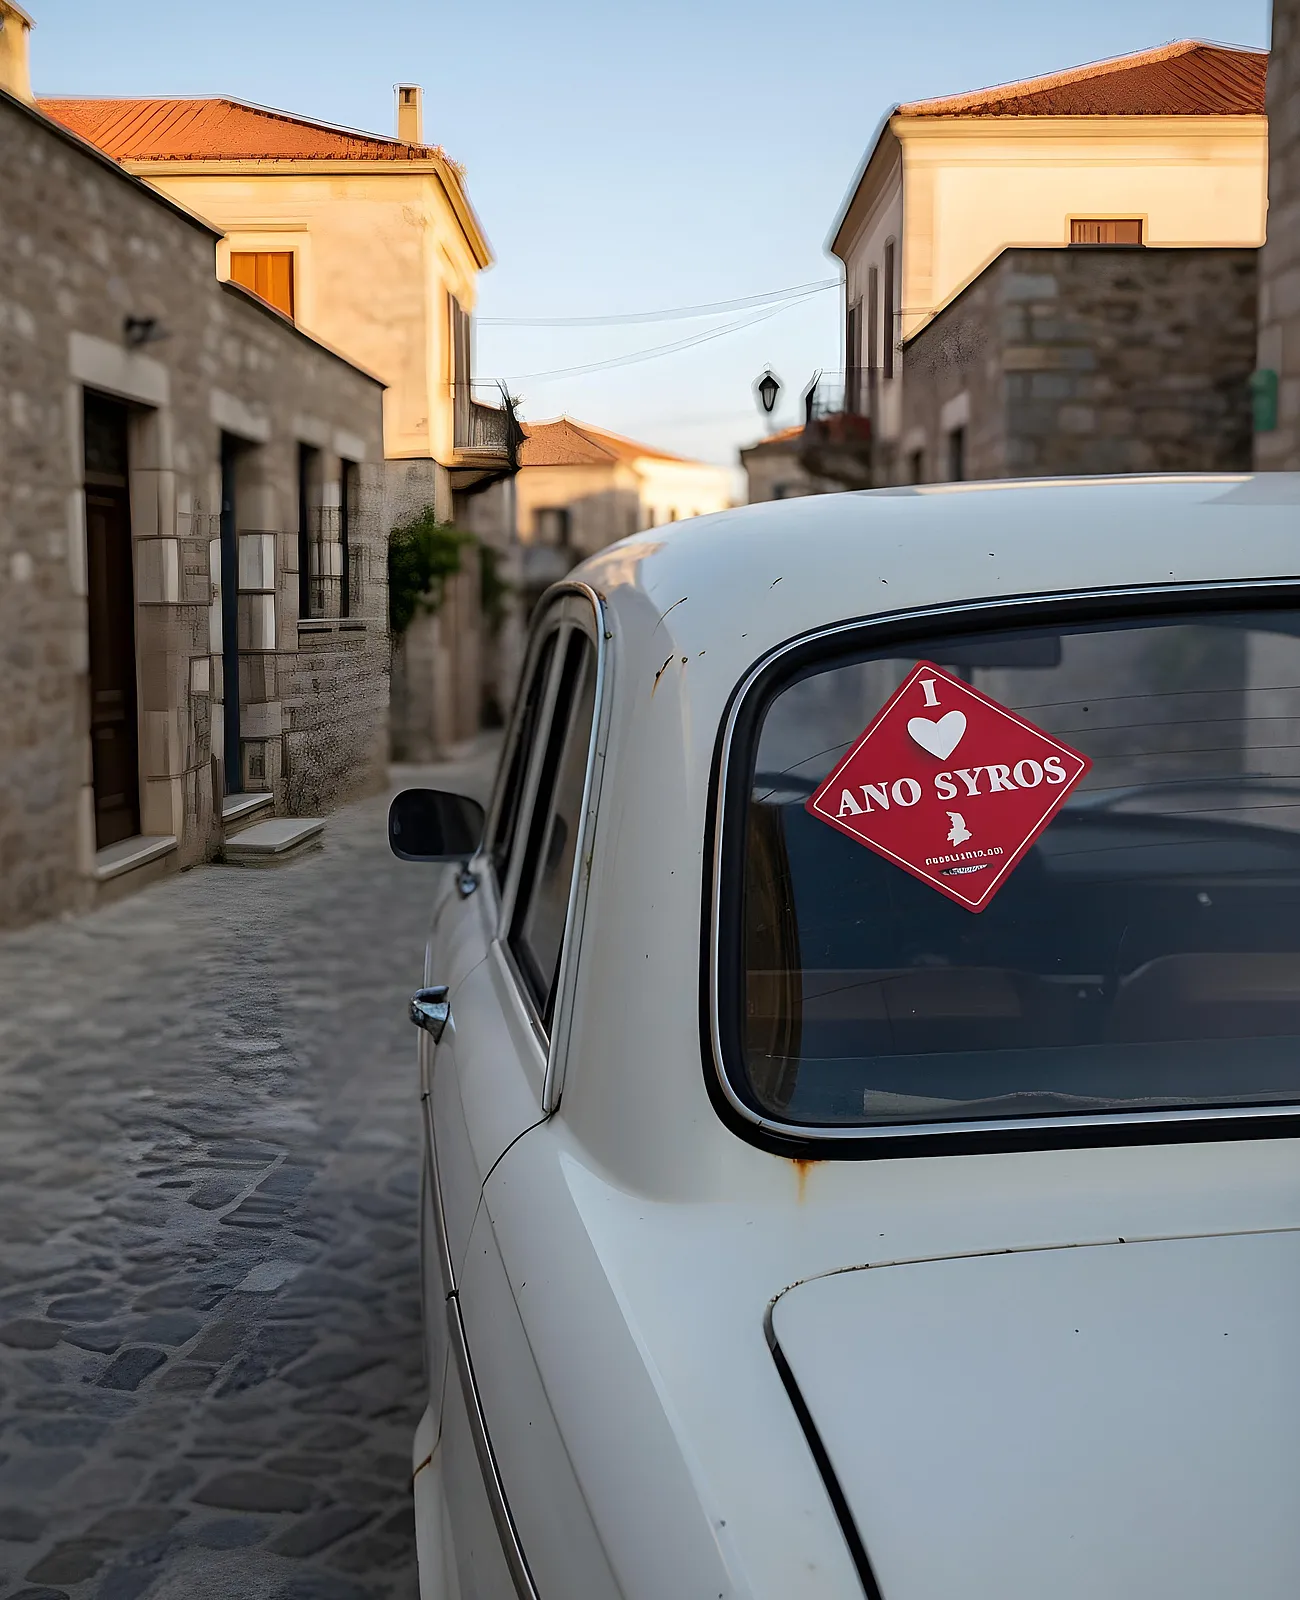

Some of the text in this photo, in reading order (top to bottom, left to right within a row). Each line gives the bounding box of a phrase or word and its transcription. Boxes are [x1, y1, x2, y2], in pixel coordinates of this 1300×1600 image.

[918, 678, 942, 708] I
[835, 756, 1067, 818] ANO SYROS
